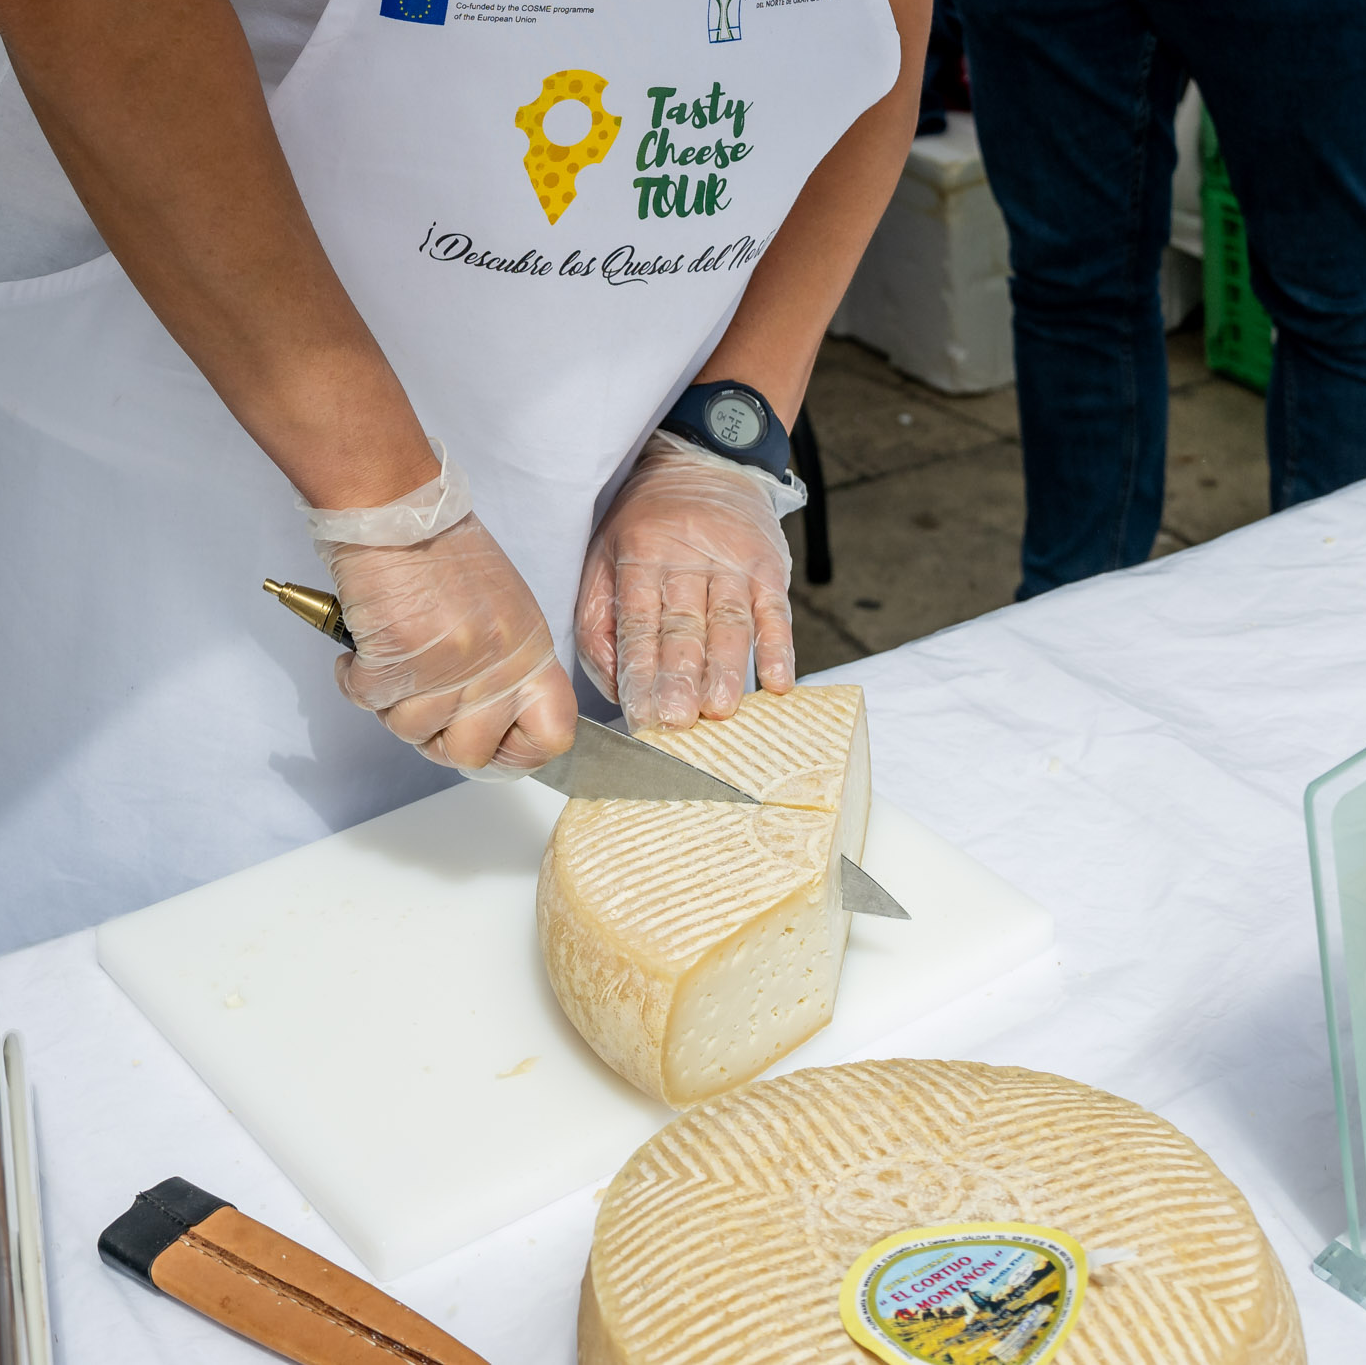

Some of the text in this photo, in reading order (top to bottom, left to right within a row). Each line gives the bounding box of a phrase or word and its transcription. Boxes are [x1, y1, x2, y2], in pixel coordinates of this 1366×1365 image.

[453, 13, 462, 21] of
[476, 14, 514, 24] European
[515, 15, 537, 24] Union
[455, 1, 595, 15] Co-funded by the COSME programme
[646, 80, 754, 140] Tasty
[635, 128, 755, 174] Cheese
[633, 172, 733, 222] TOUR
[558, 250, 597, 278] los
[601, 244, 685, 287] Quesos
[687, 244, 727, 273] del
[910, 1256, 973, 1294] CORTIJO
